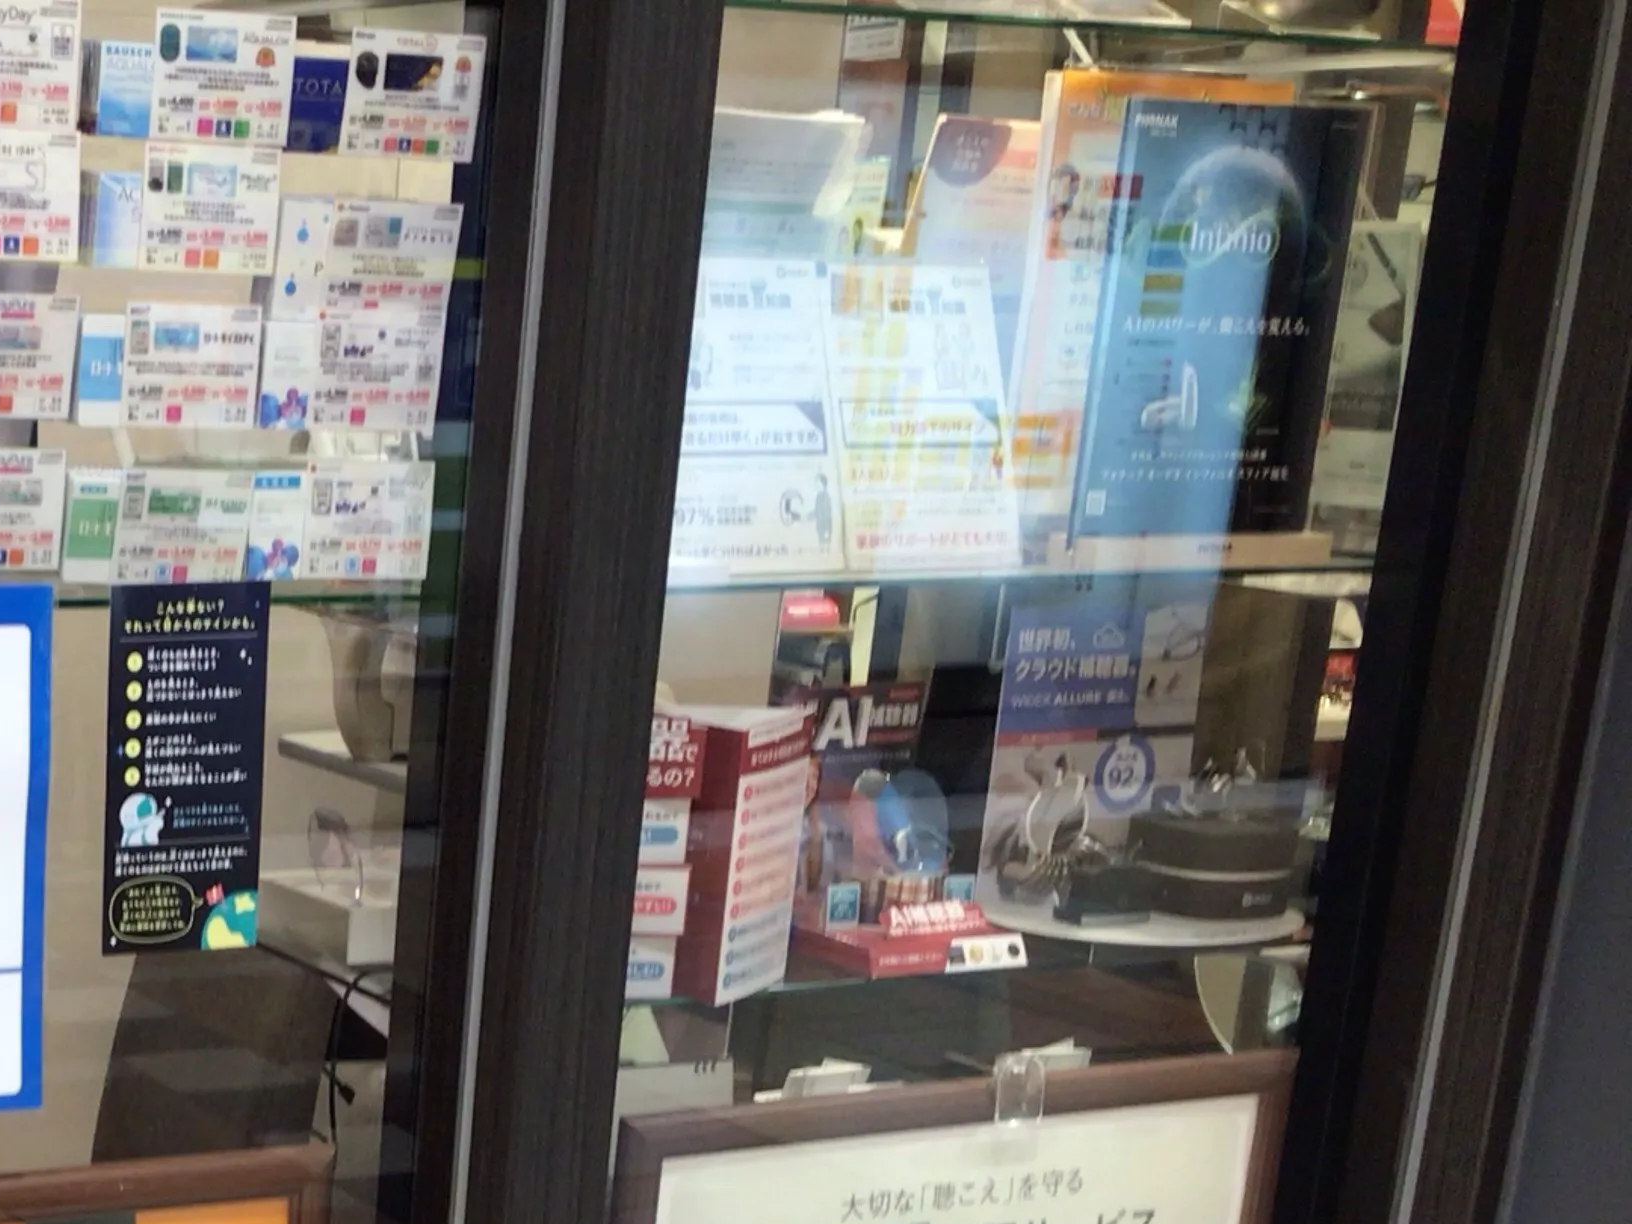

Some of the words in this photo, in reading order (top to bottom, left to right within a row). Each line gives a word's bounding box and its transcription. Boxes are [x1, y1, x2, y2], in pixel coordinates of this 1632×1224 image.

[105, 46, 152, 58] BAUSCH
[840, 1168, 1084, 1223] 大切な「聴こえ」を守る
